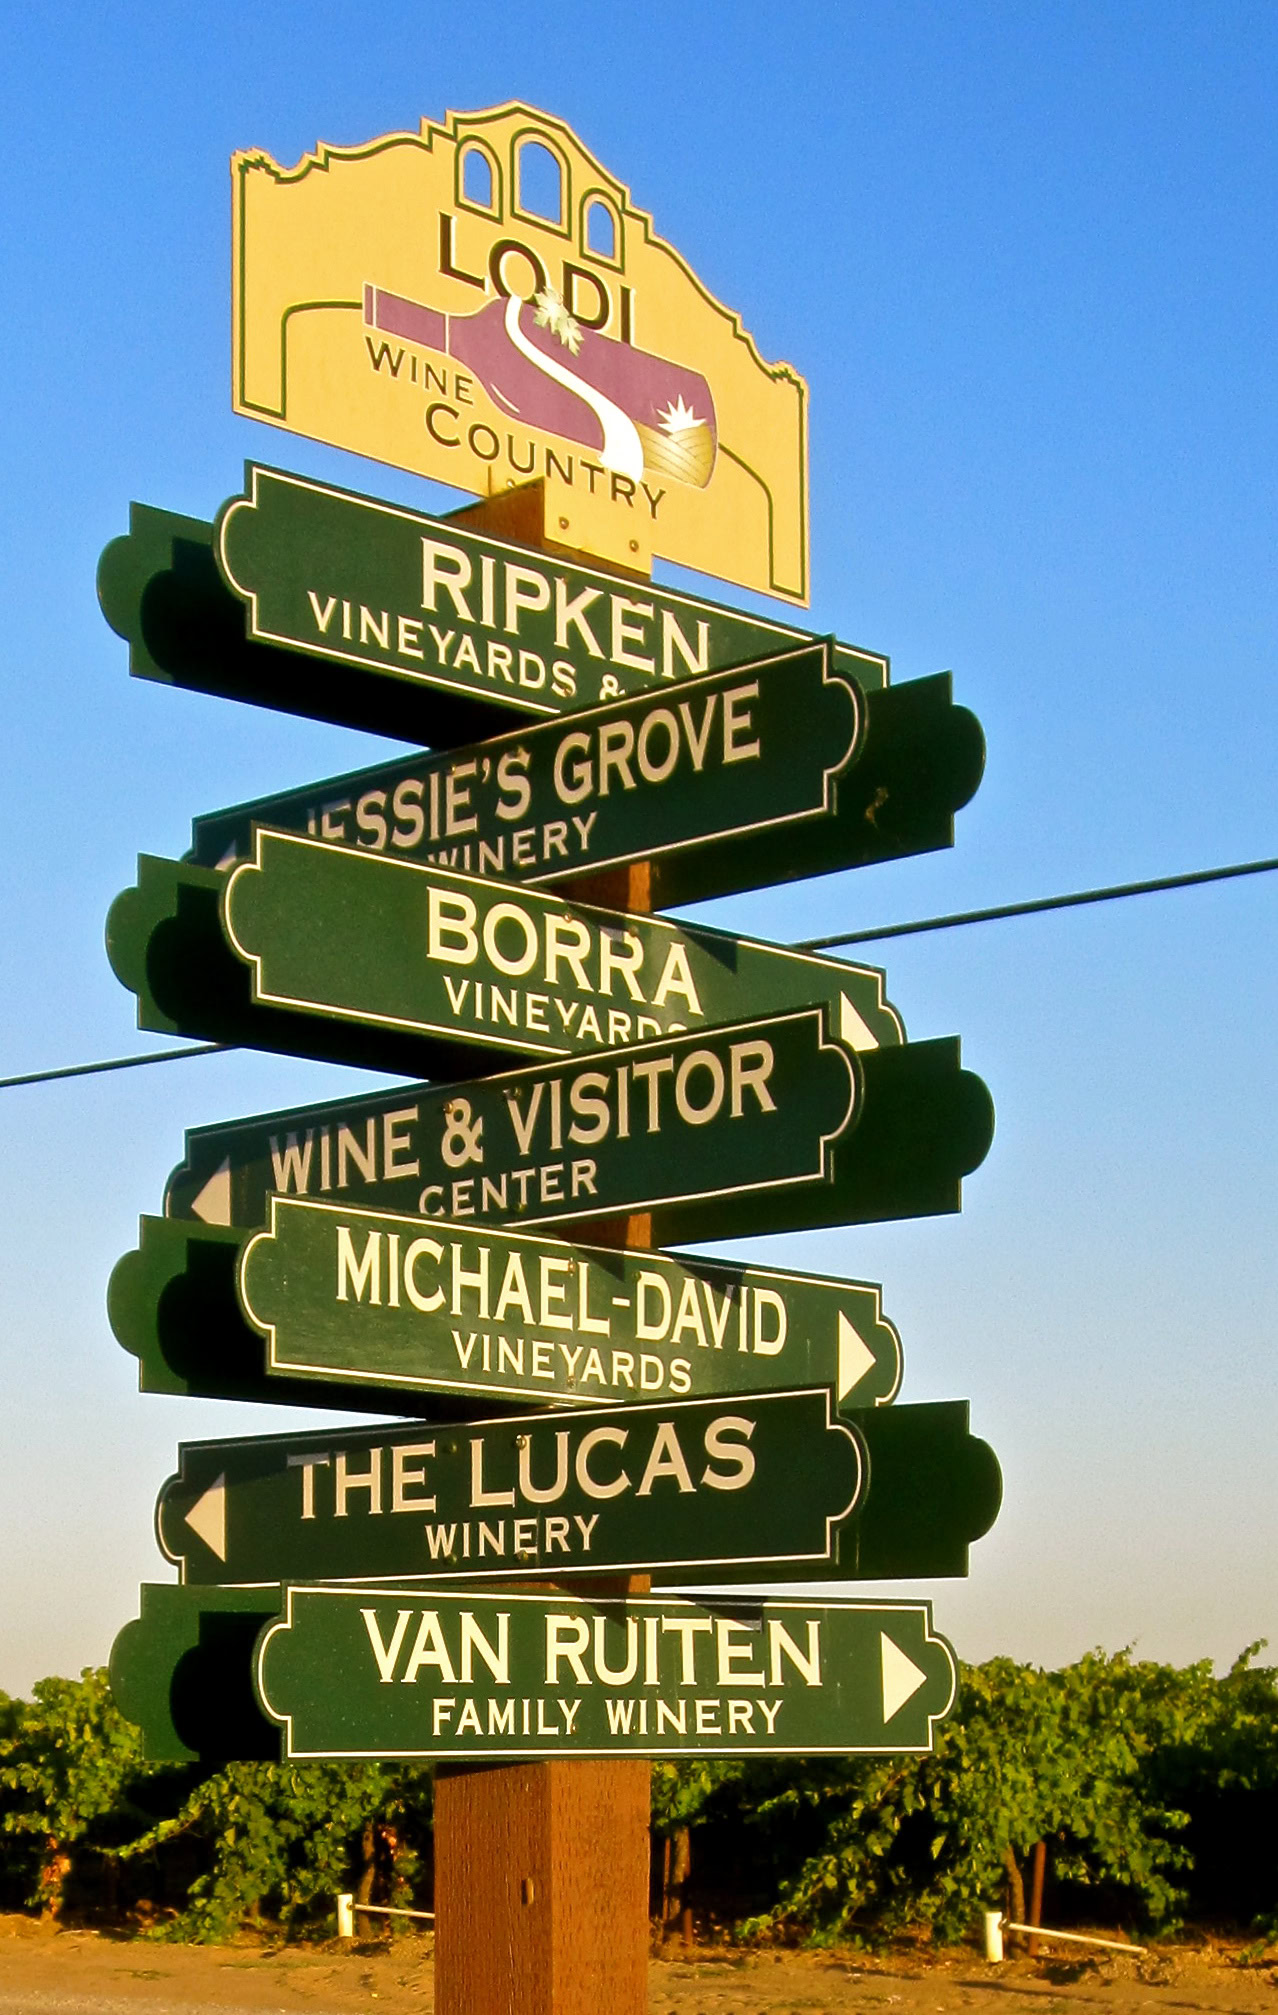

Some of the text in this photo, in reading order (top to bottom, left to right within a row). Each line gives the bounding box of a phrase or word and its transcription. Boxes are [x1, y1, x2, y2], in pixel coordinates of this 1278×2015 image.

[438, 211, 634, 346] LODI
[365, 336, 474, 405] WINE
[425, 402, 667, 520] COUNTRY
[307, 591, 576, 698] VINEYARDS
[420, 537, 710, 679] RIPKEN
[553, 681, 762, 804] GROVE
[426, 886, 705, 1016] BORRA
[443, 975, 688, 1045] VINEYARD
[269, 1040, 777, 1195] WINE & VISITOR
[418, 1159, 599, 1218] CENTER
[335, 1226, 789, 1357] MICHAEL-DAVID
[452, 1330, 693, 1395] VINEYARDS
[286, 1416, 757, 1520] THE LUCAS
[424, 1513, 600, 1561] WINERY
[360, 1608, 823, 1688] VAN RUITEN
[431, 1699, 785, 1736] FAMILY WINERY
